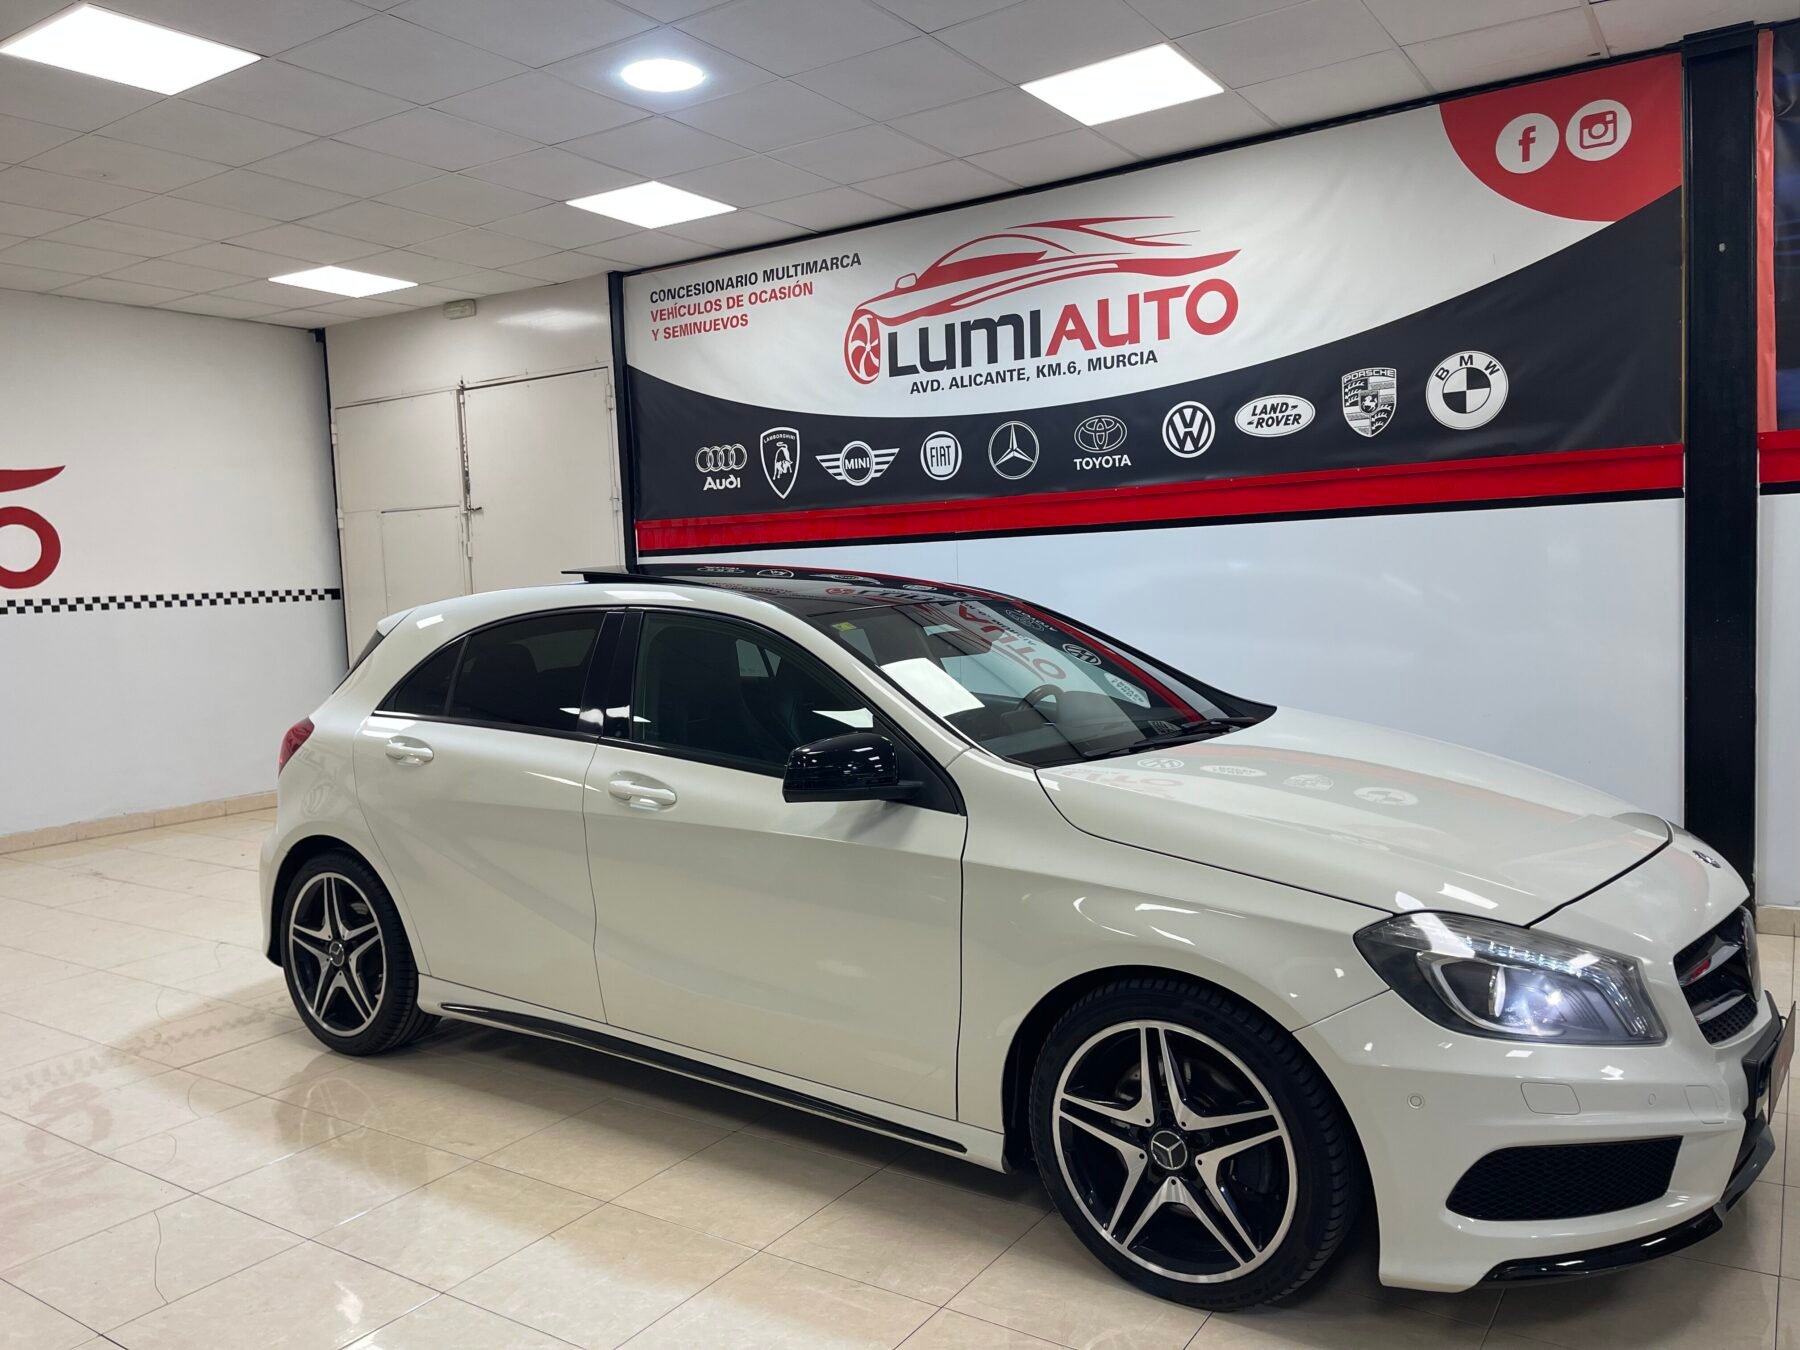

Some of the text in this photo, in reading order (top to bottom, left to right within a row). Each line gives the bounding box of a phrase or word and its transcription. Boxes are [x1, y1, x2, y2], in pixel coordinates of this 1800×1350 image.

[650, 252, 862, 304] CONCESIONARIO MULTIMARCA
[650, 280, 814, 323] VEHÍCULOS DE OCASIÓN
[651, 313, 749, 342] Y SEMINUEVOS
[910, 350, 1158, 395] AVD. ALICANTE, KM.6, MURCIA
[1343, 368, 1396, 383] PORSCHE
[1434, 354, 1500, 381] BMW
[844, 457, 870, 470] MINI
[930, 445, 952, 468] FIAT
[1073, 454, 1132, 471] TOYOTA
[703, 474, 741, 490] Audi
